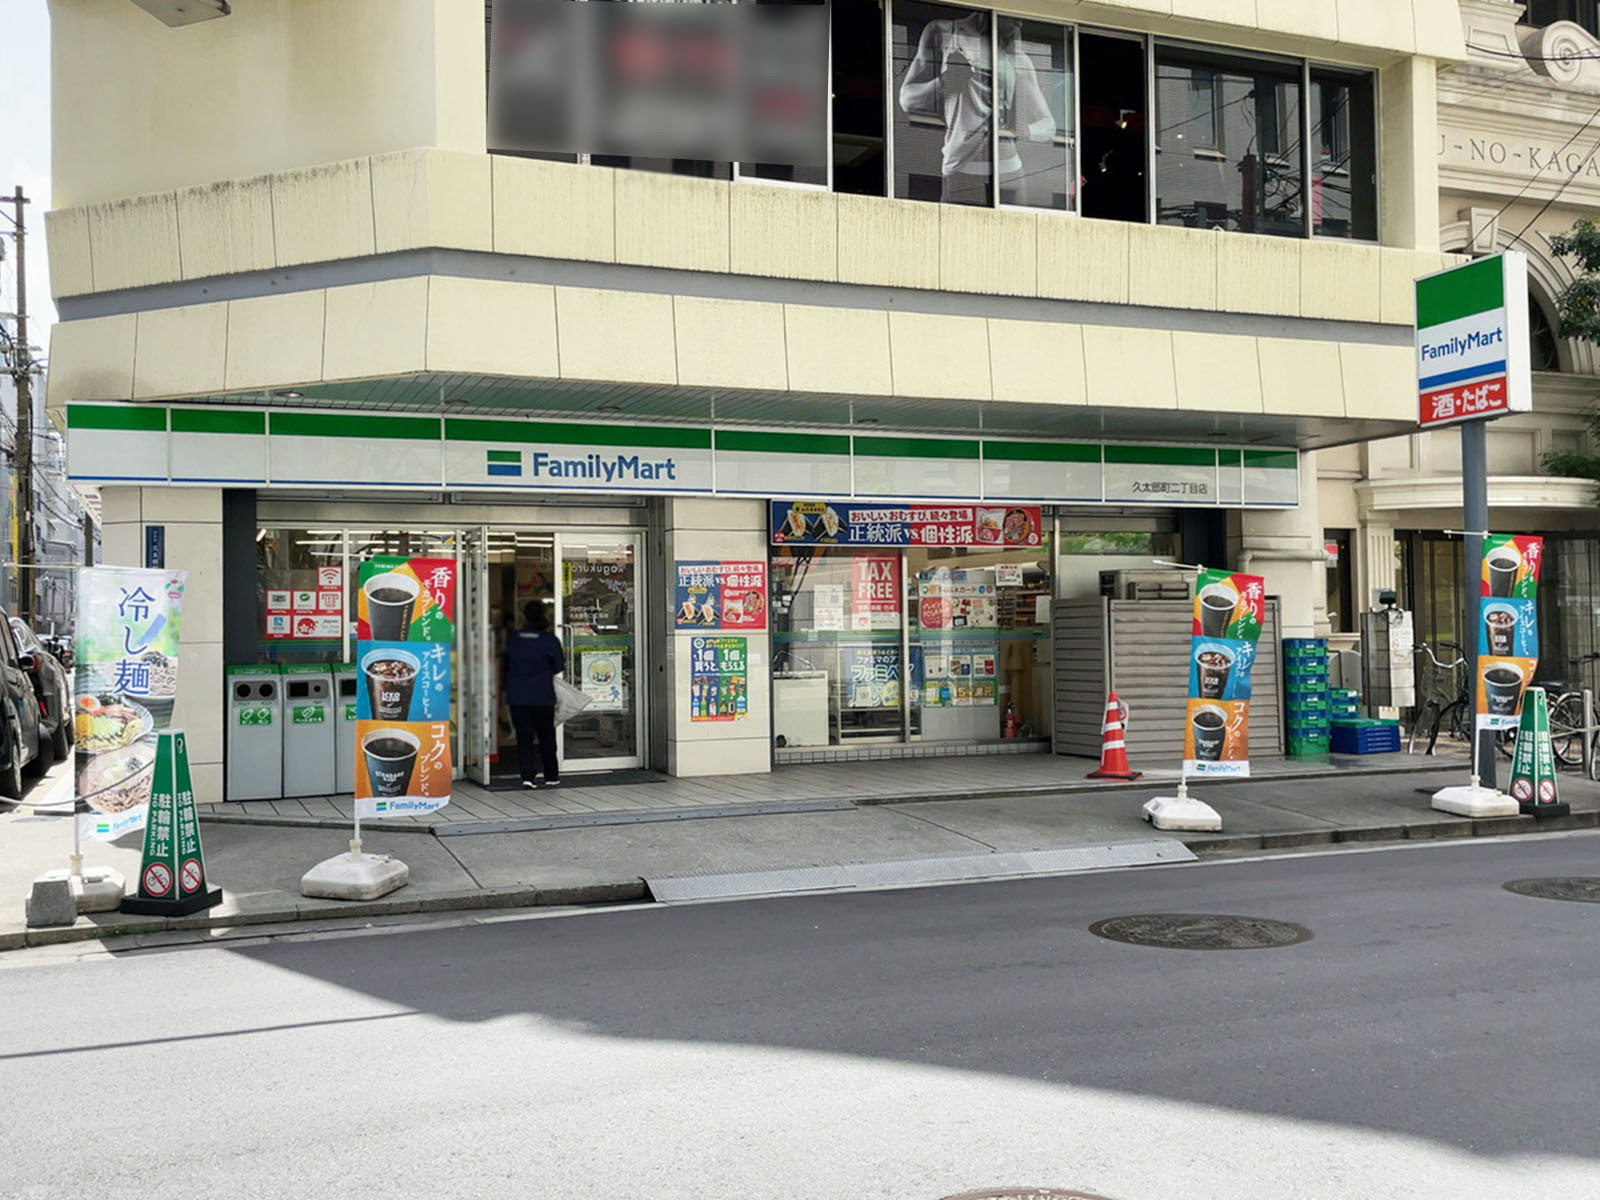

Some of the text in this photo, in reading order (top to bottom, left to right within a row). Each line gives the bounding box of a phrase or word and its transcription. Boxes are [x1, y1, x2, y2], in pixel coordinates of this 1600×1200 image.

[1421, 328, 1503, 361] FamilyMart
[533, 453, 676, 482] FamilyMart
[858, 561, 893, 580] TAX
[857, 581, 894, 599] FREE
[113, 586, 156, 695] 冷し麺
[429, 724, 446, 770] コクの
[389, 800, 441, 812] FamilyMart
